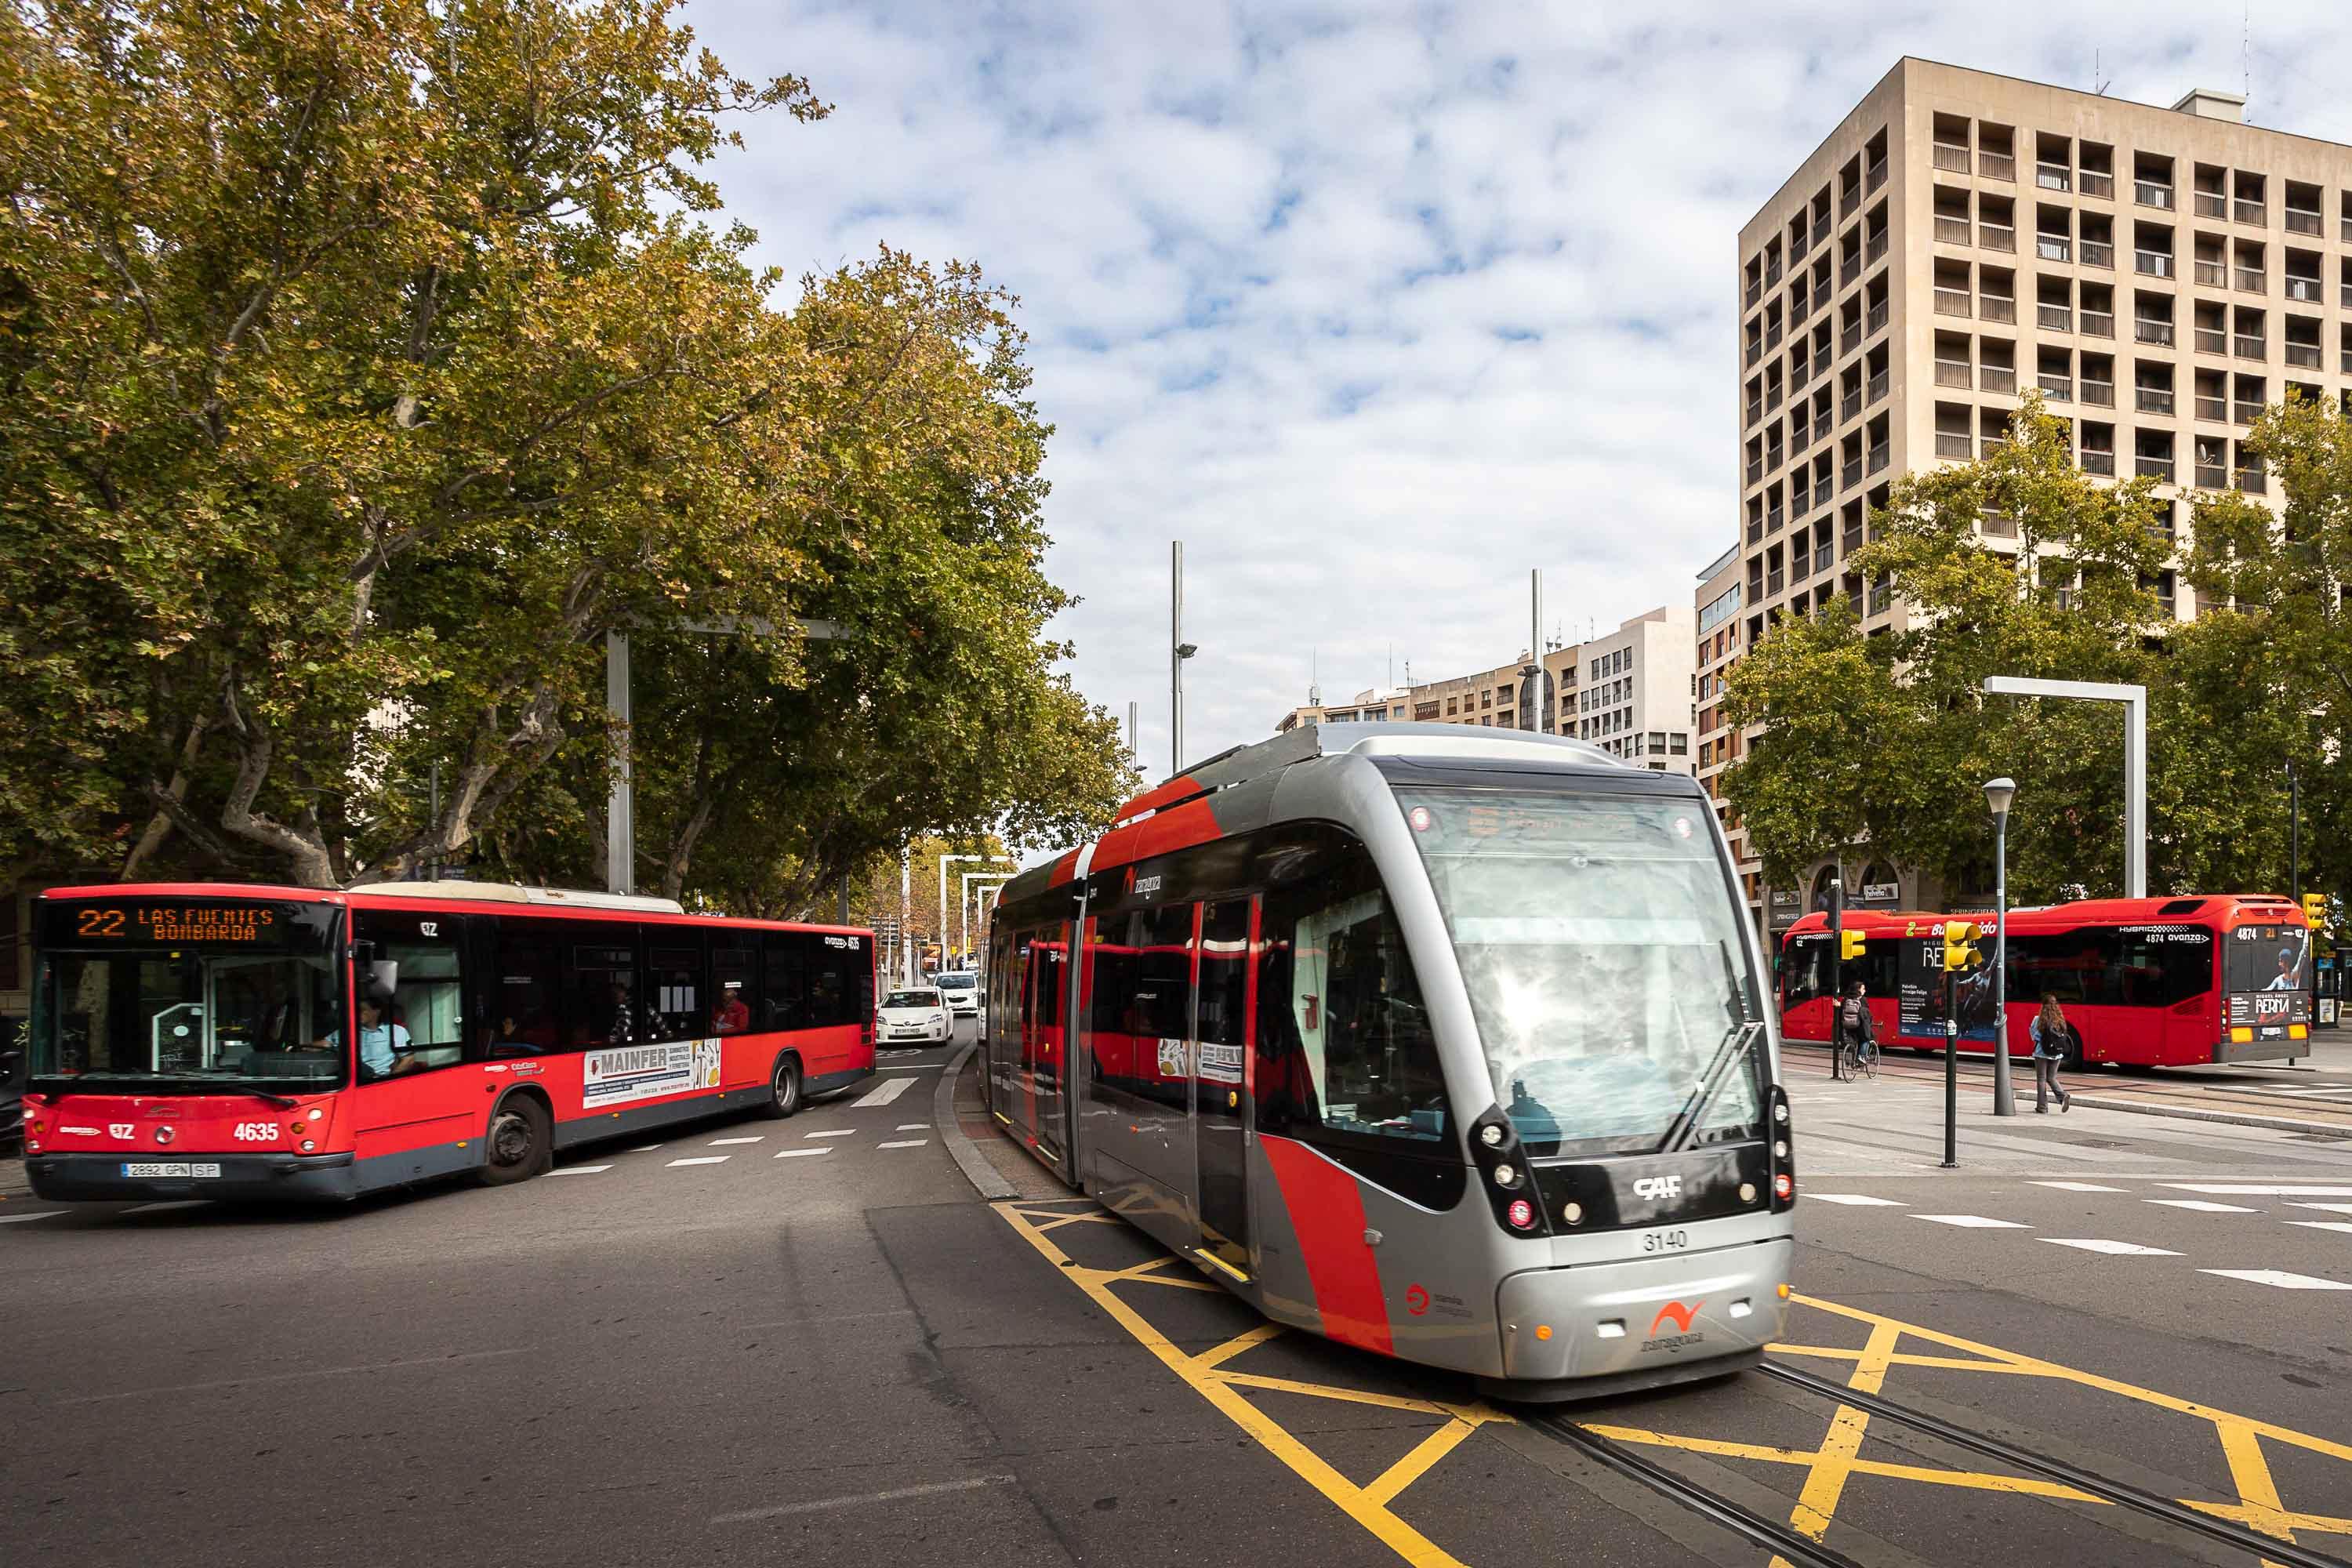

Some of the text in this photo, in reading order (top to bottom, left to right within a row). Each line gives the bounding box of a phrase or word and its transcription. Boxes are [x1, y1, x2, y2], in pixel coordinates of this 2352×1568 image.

[78, 909, 126, 936] 22
[137, 909, 273, 925] LAS FUENTES
[154, 924, 256, 940] BOMBARDA
[1931, 924, 1945, 936] Bu
[2237, 927, 2257, 940] 4874
[2264, 927, 2277, 938] 21
[2146, 934, 2164, 943] 4874
[601, 1048, 666, 1073] MAINFER
[234, 1123, 279, 1141] 4635
[131, 1164, 161, 1175] 2892
[165, 1163, 189, 1175] GPN
[1633, 1175, 1681, 1200] CAF
[1643, 1230, 1687, 1251] 3140
